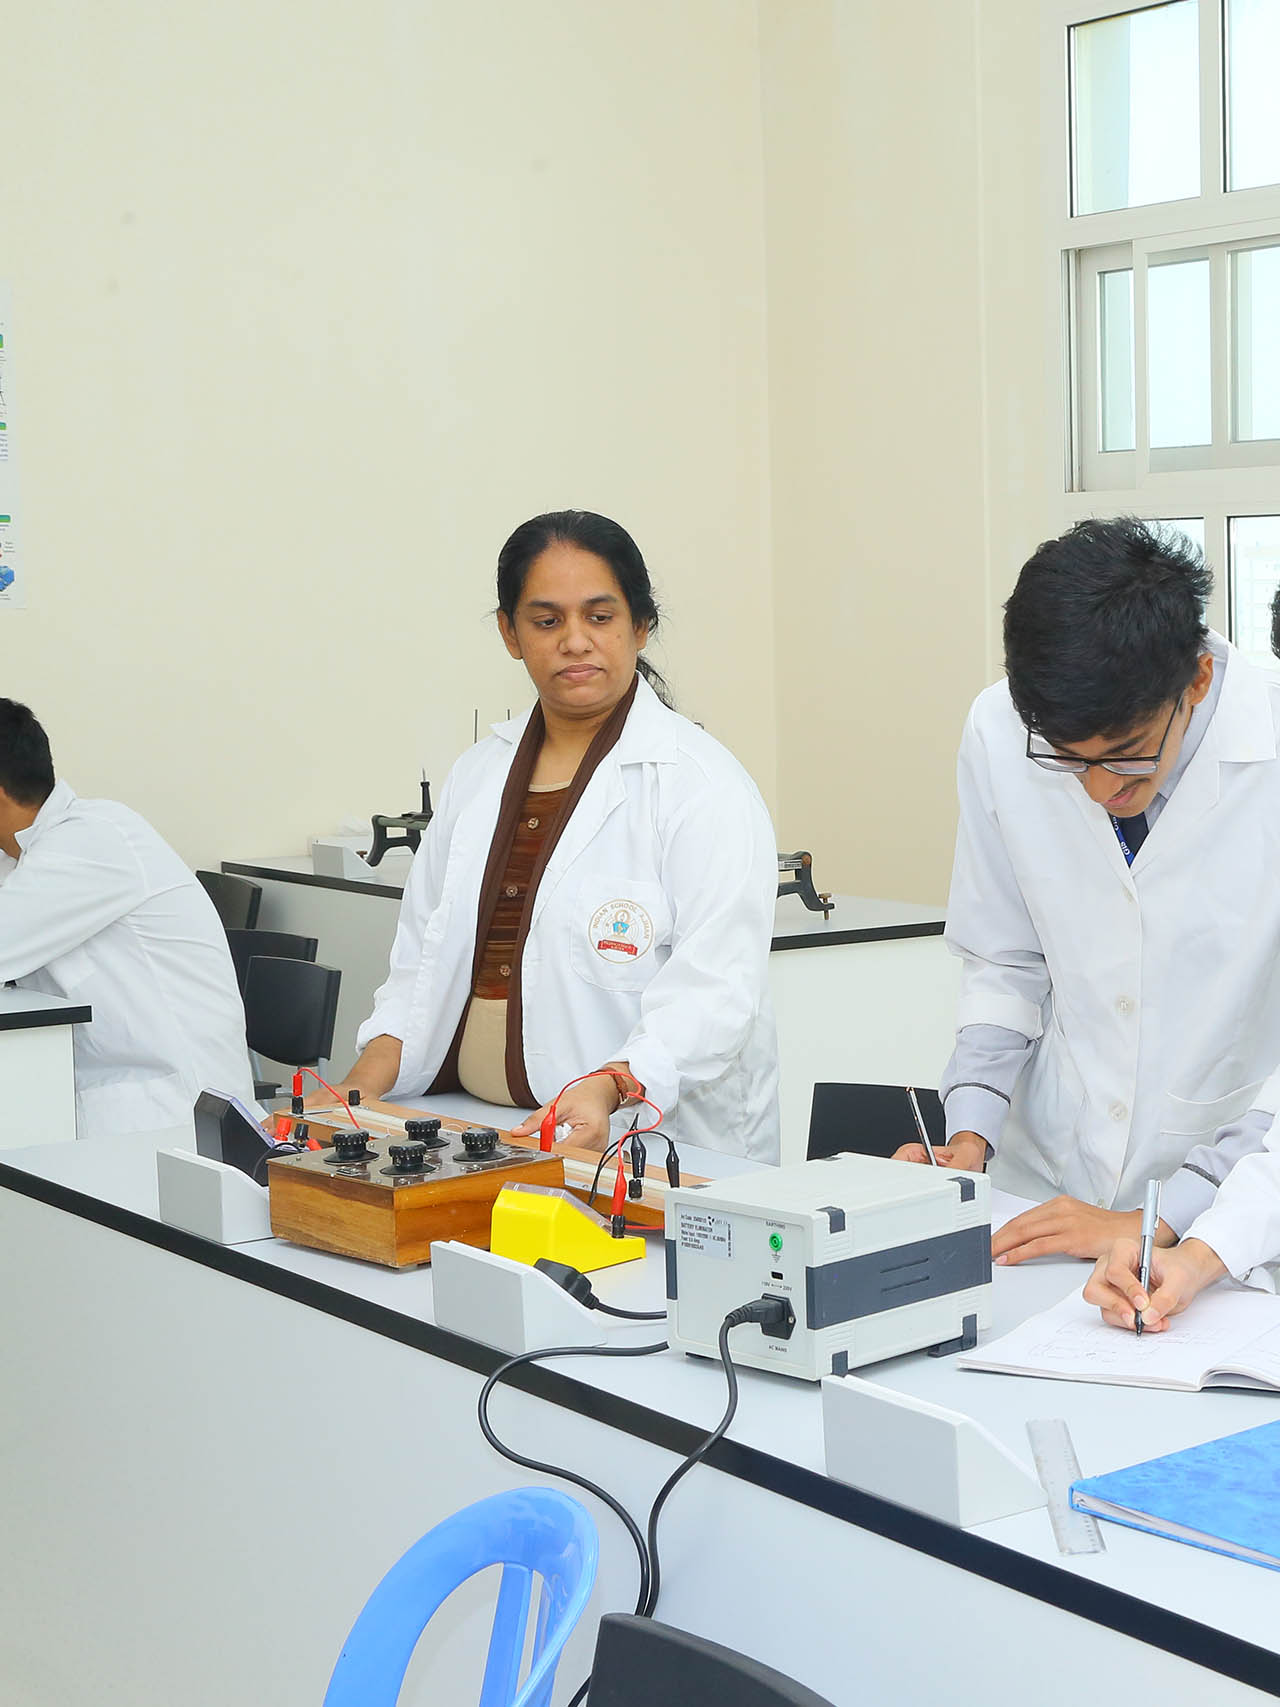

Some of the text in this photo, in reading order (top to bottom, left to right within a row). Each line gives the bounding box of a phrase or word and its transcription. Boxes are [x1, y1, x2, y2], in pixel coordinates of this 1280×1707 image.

[1120, 841, 1131, 856] GIS
[593, 908, 608, 928] INDIAN
[611, 903, 637, 913] SCHOOL
